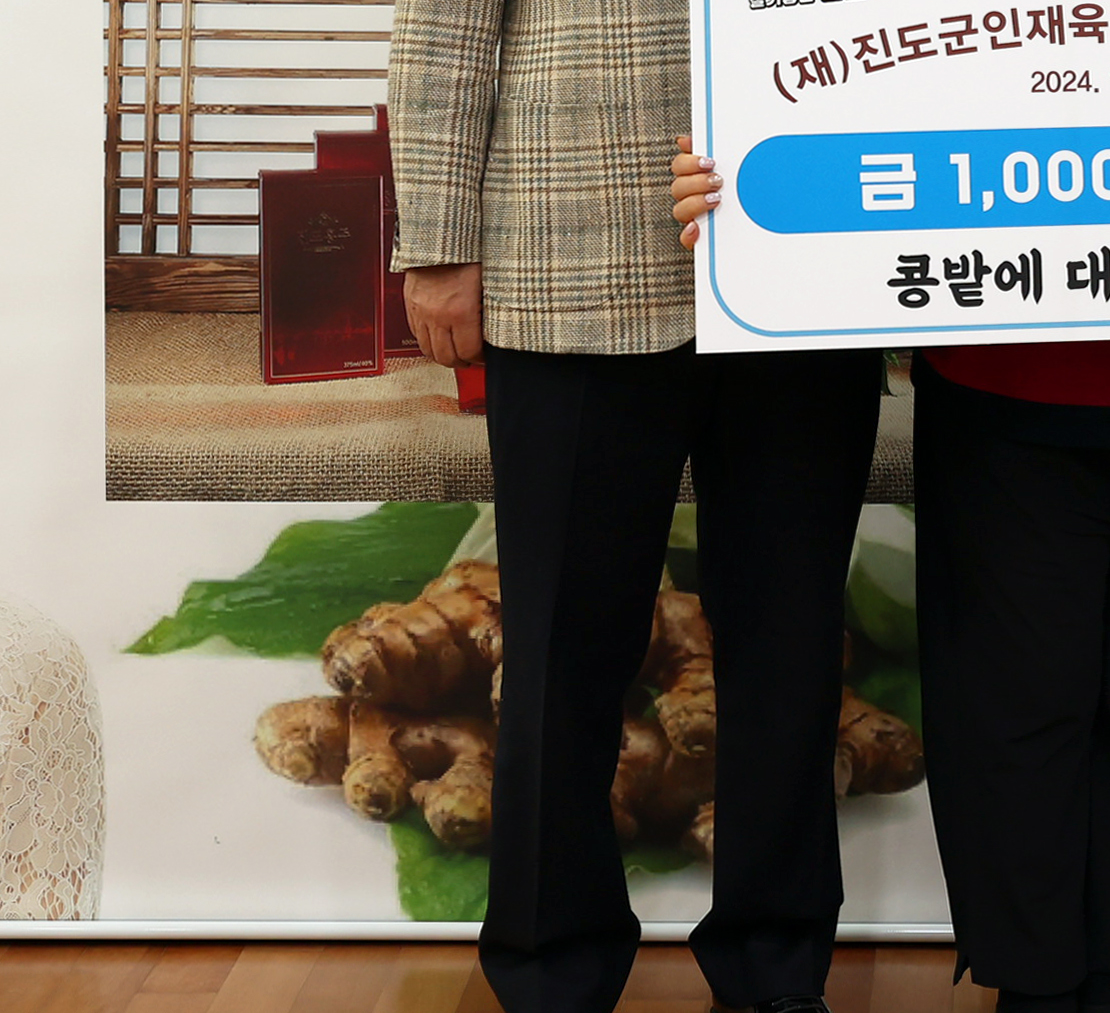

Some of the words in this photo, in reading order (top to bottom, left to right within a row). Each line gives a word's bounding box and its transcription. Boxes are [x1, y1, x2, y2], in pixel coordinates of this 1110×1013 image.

[1031, 70, 1100, 93] 2024.
[859, 153, 917, 212] 금
[887, 247, 1043, 309] 콩밭에
